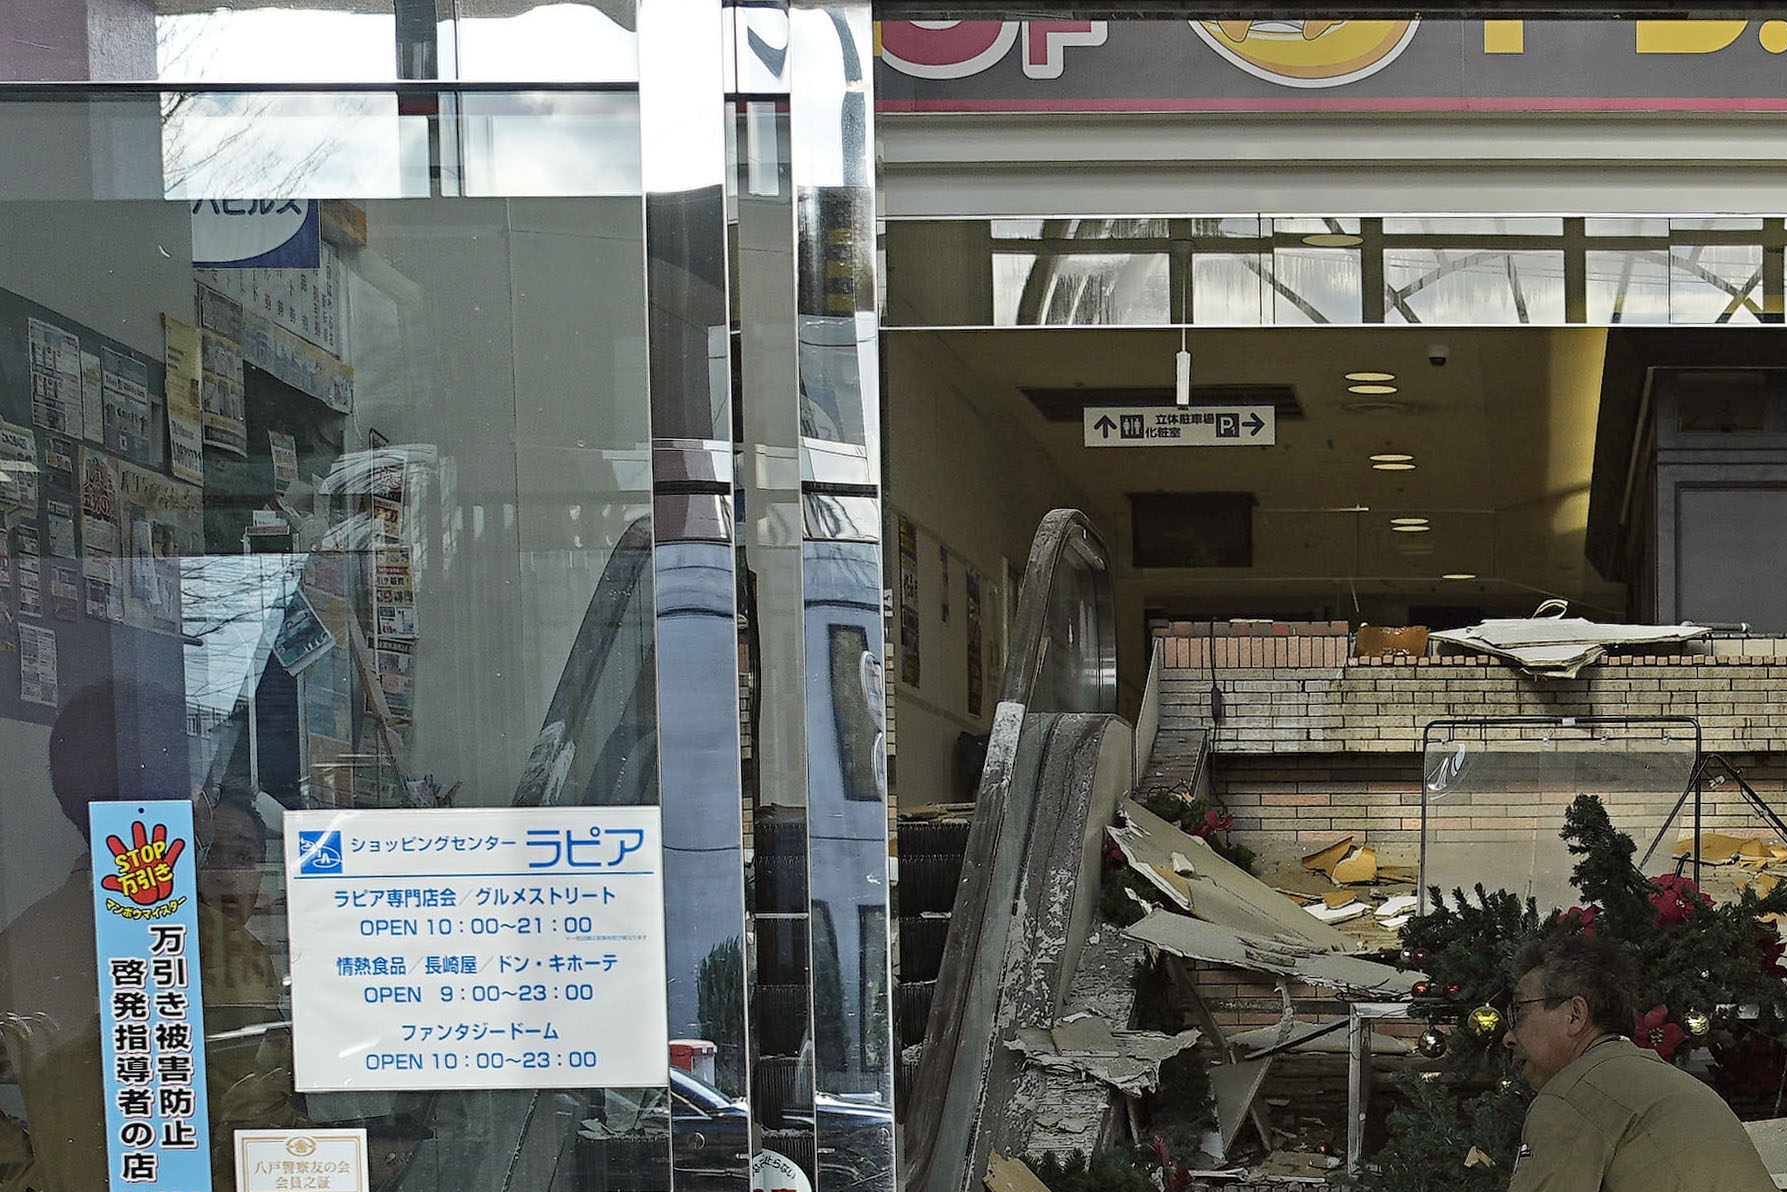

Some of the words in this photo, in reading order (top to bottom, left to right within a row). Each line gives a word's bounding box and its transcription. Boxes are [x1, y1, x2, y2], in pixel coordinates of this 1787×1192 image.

[1155, 413, 1215, 425] 立体駐車場
[1145, 427, 1181, 438] 化粧室
[350, 835, 516, 853] ショッピングセンター
[526, 826, 645, 868] ラピア
[115, 841, 166, 873] STOP
[117, 863, 174, 896] 万引き
[359, 919, 418, 936] OPEN
[363, 986, 422, 1003] OPEN
[150, 924, 197, 1149] 万引き被害防止
[400, 1022, 560, 1042] ファンタジードーム
[109, 958, 158, 1182] 啓発指導者の店
[365, 1053, 424, 1070] OPEN
[254, 1160, 351, 1175] 八戸警察友の会
[275, 1175, 331, 1190] 会員之証
